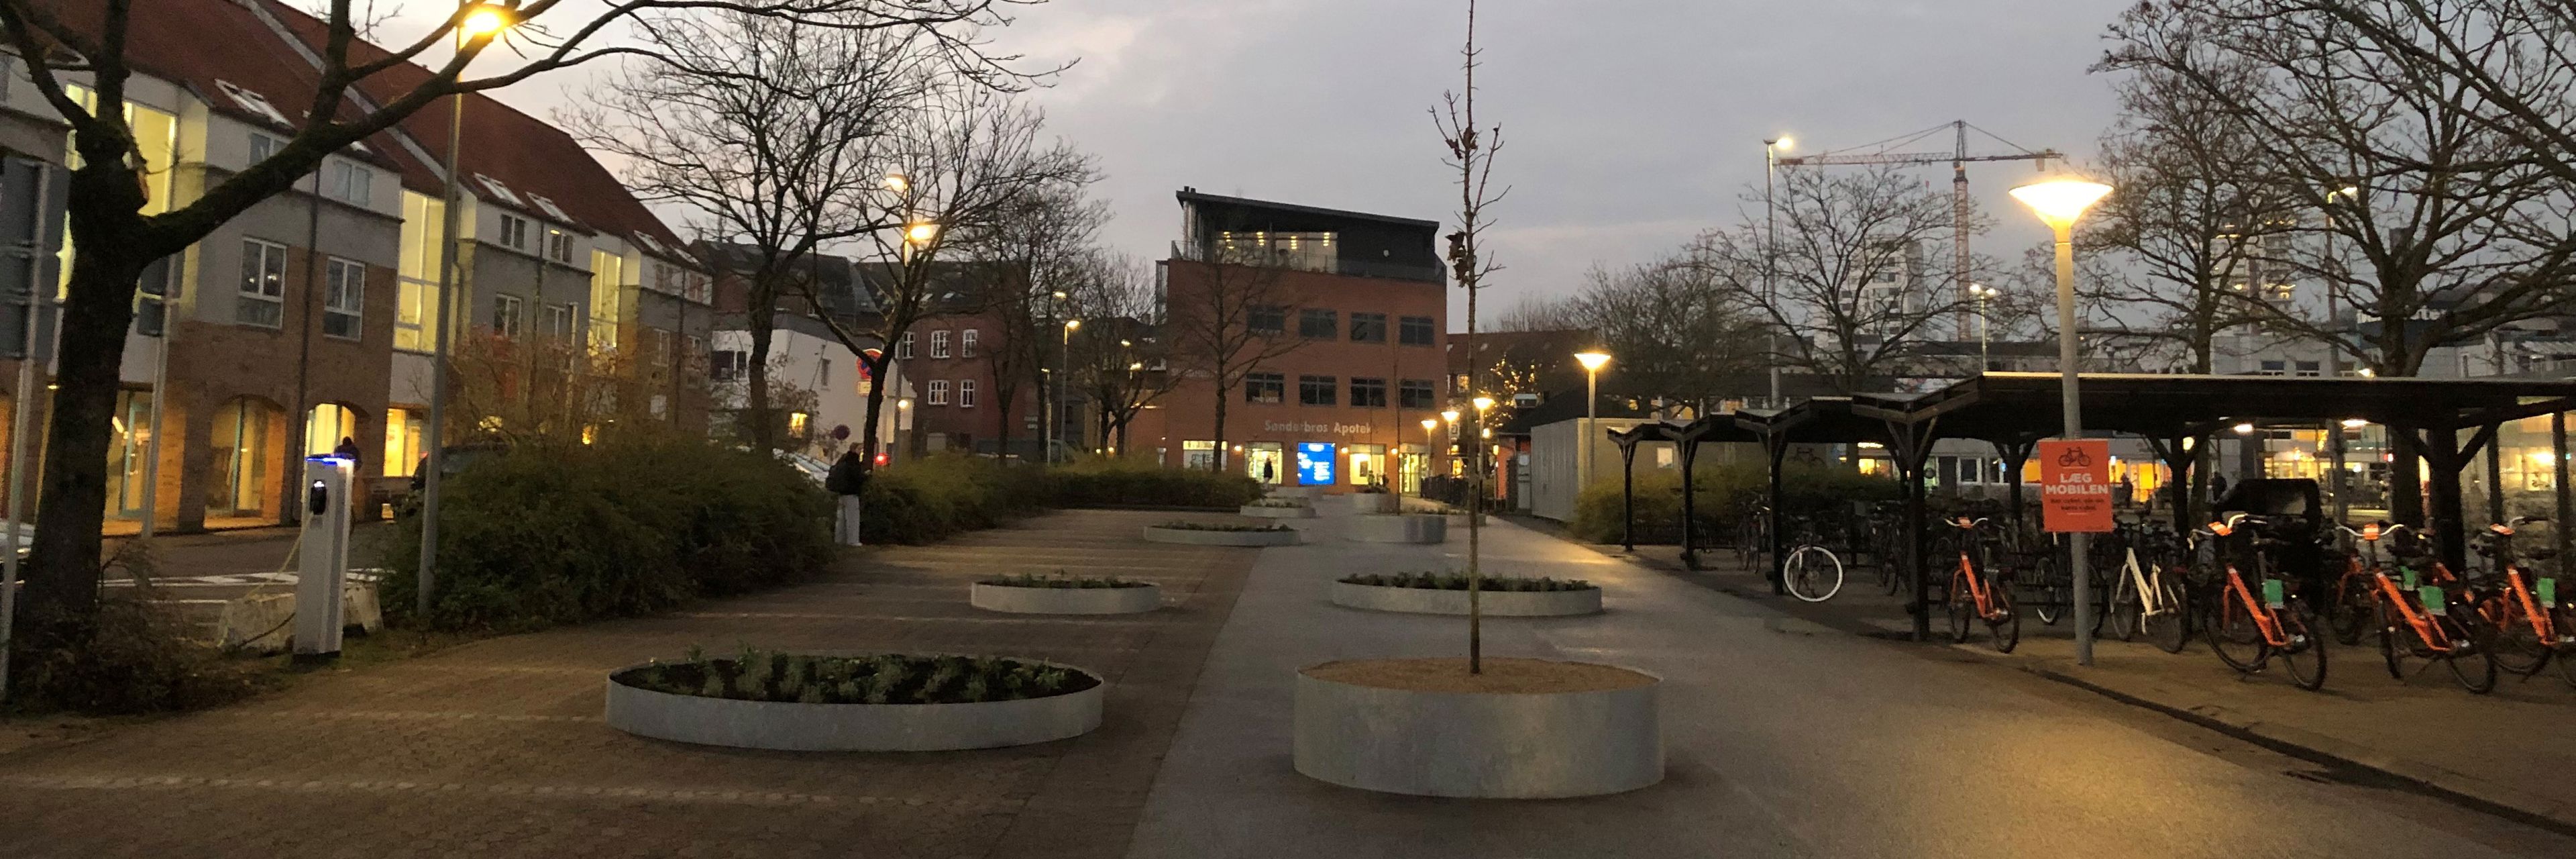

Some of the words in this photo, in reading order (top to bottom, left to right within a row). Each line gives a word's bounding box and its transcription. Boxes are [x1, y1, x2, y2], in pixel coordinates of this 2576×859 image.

[1334, 421, 1371, 436] Apotek
[2060, 473, 2092, 483] LÆG
[2045, 484, 2108, 495] MOBILEN
